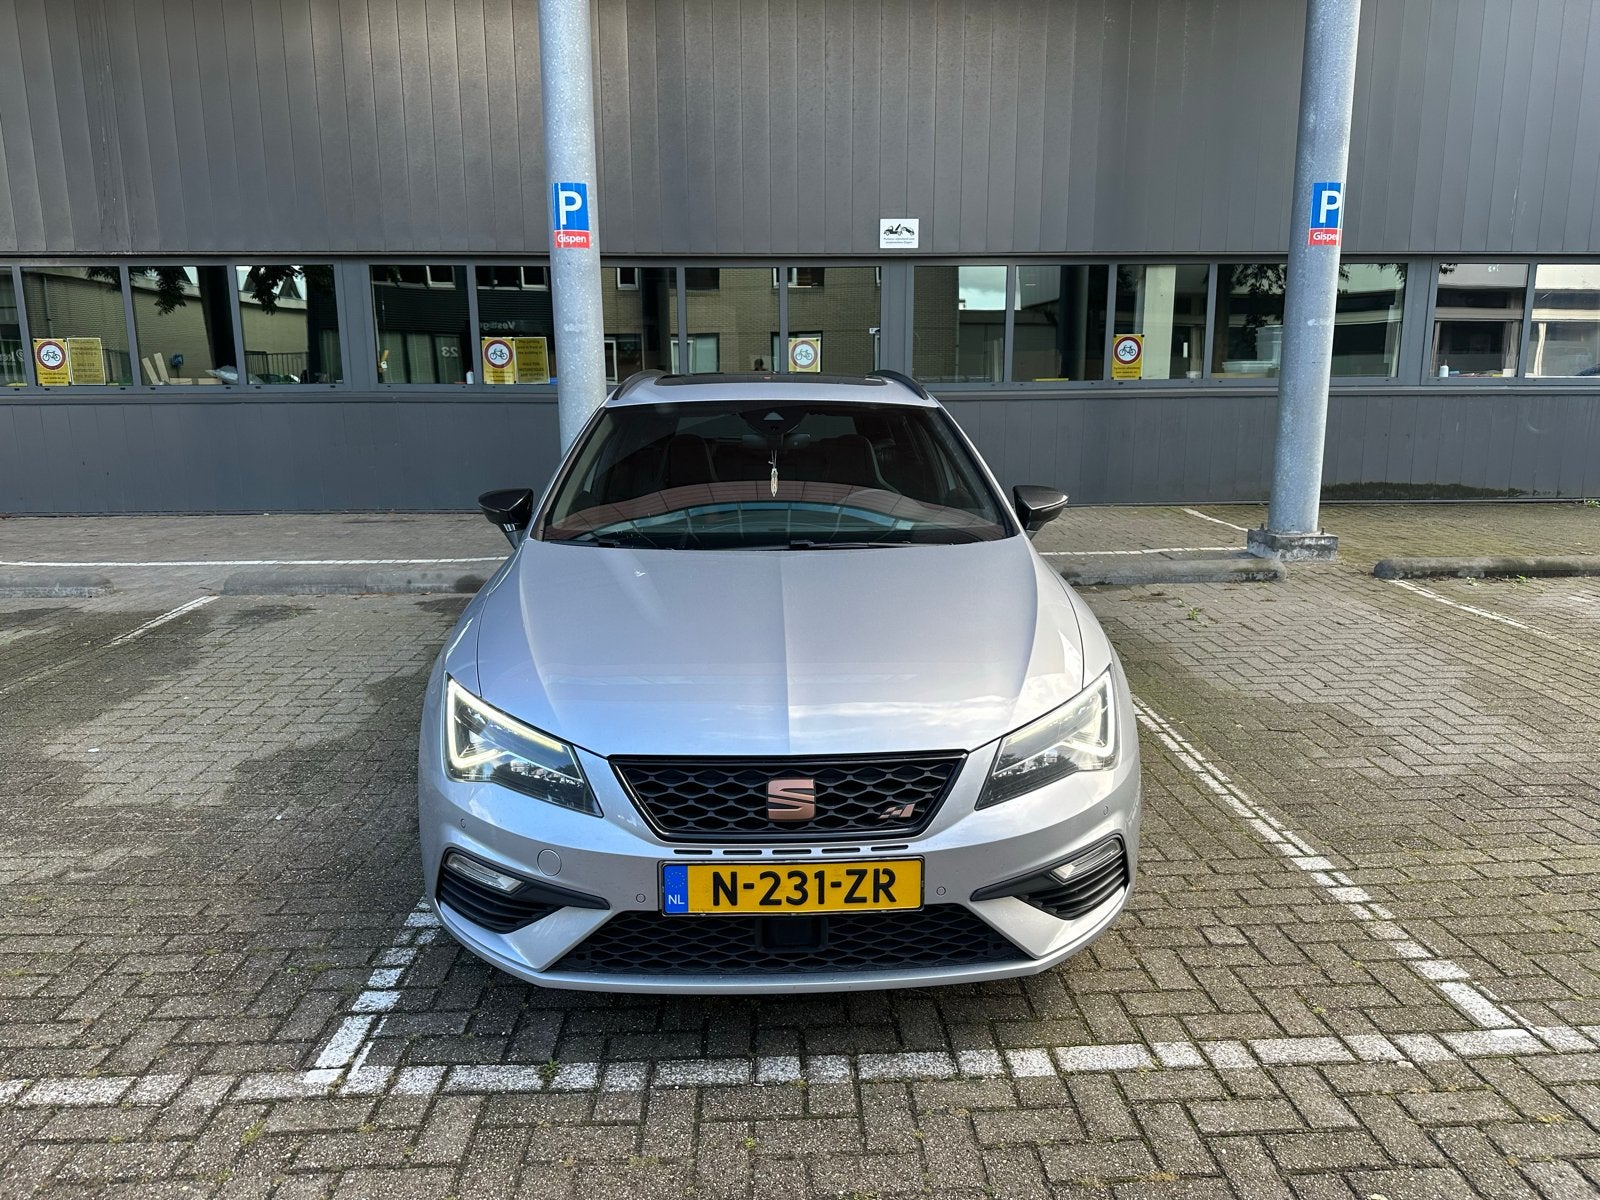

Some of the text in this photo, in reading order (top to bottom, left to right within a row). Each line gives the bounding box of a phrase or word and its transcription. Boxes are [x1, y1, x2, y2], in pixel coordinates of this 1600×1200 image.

[559, 190, 582, 225] P
[1319, 190, 1342, 223] P
[557, 234, 587, 245] Gispen
[668, 868, 897, 907] NL N-231-ZR
